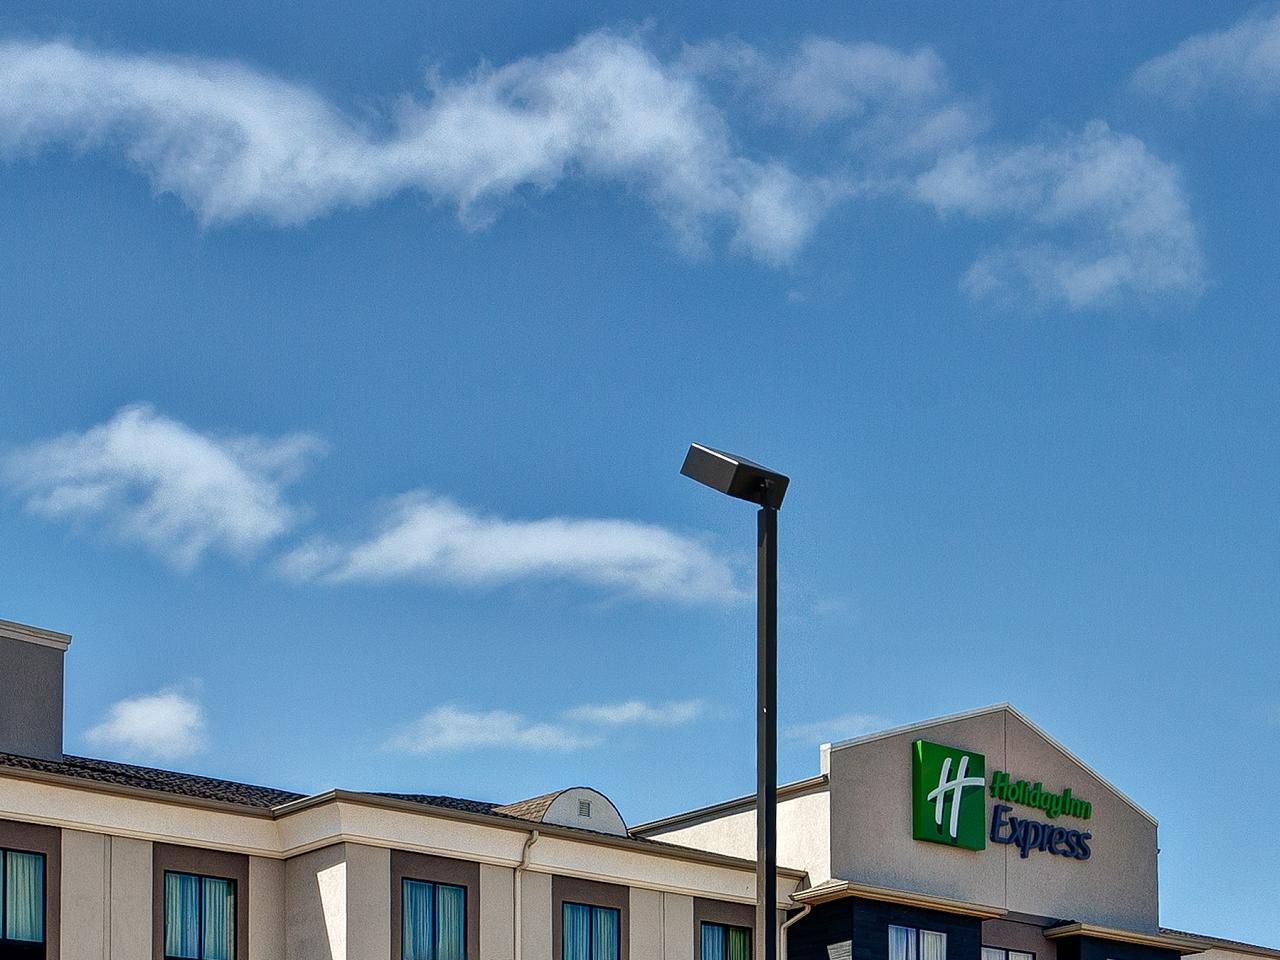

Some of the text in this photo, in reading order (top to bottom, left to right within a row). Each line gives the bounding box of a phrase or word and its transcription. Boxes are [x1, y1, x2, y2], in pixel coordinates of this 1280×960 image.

[990, 771, 1092, 819] Holiday Inn
[990, 804, 1092, 859] Express
